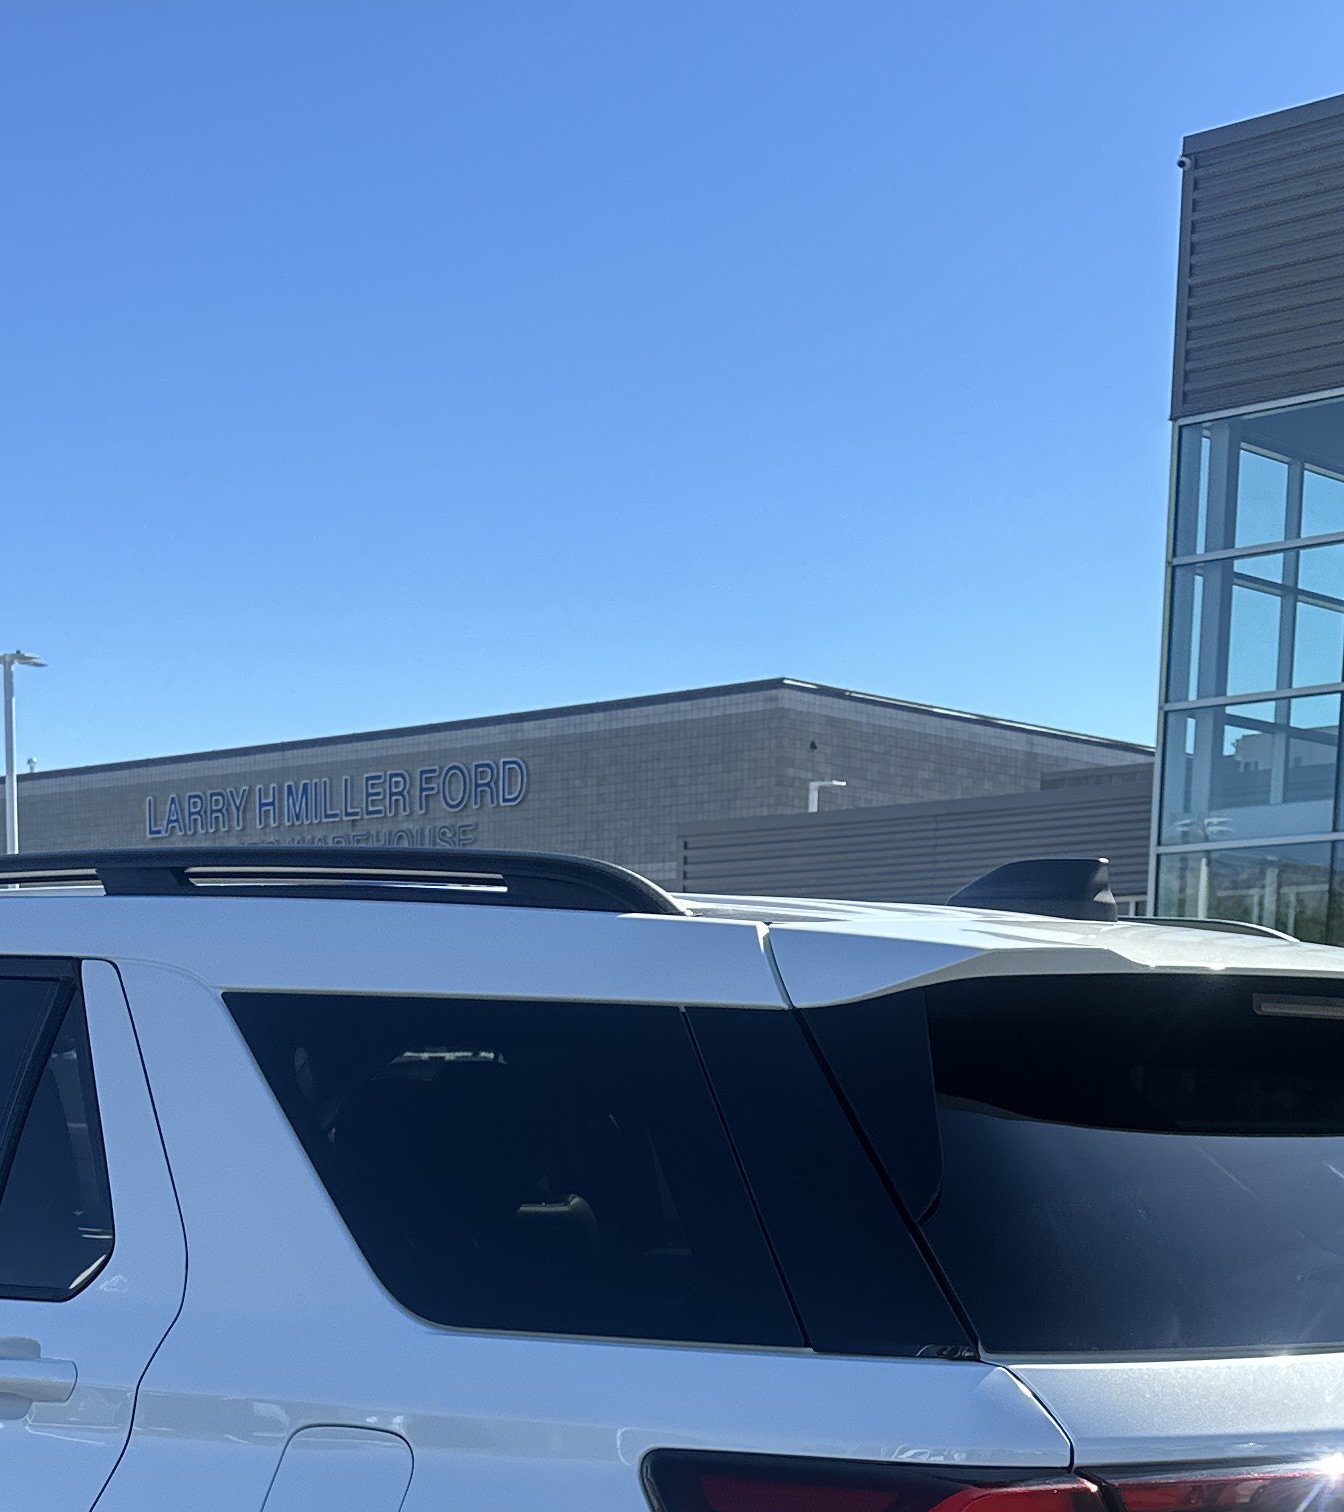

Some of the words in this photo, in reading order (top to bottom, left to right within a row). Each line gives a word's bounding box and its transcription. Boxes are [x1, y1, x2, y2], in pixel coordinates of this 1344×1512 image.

[146, 786, 248, 838] LARRY
[256, 784, 278, 828] H
[284, 770, 410, 826] MILLER
[416, 758, 528, 813] FORD
[288, 823, 478, 847] HOUSE
